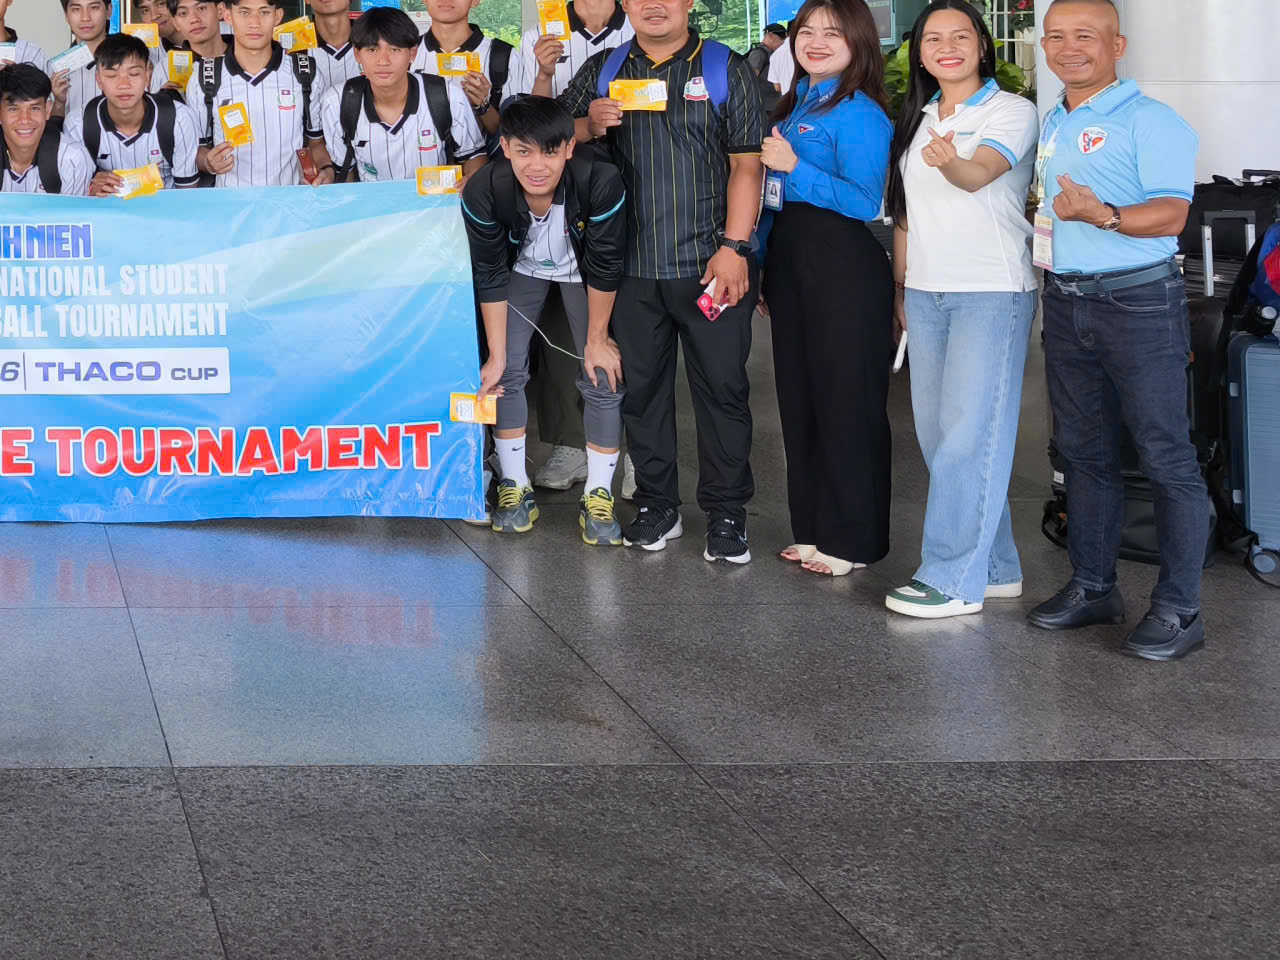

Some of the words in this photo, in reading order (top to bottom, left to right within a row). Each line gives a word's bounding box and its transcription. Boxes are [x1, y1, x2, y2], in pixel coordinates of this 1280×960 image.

[119, 263, 229, 297] STUDENT
[54, 302, 229, 337] TOURNAMENT
[34, 360, 163, 382] THACO
[169, 366, 220, 381] CUP
[46, 421, 442, 477] TOURNAMENT
